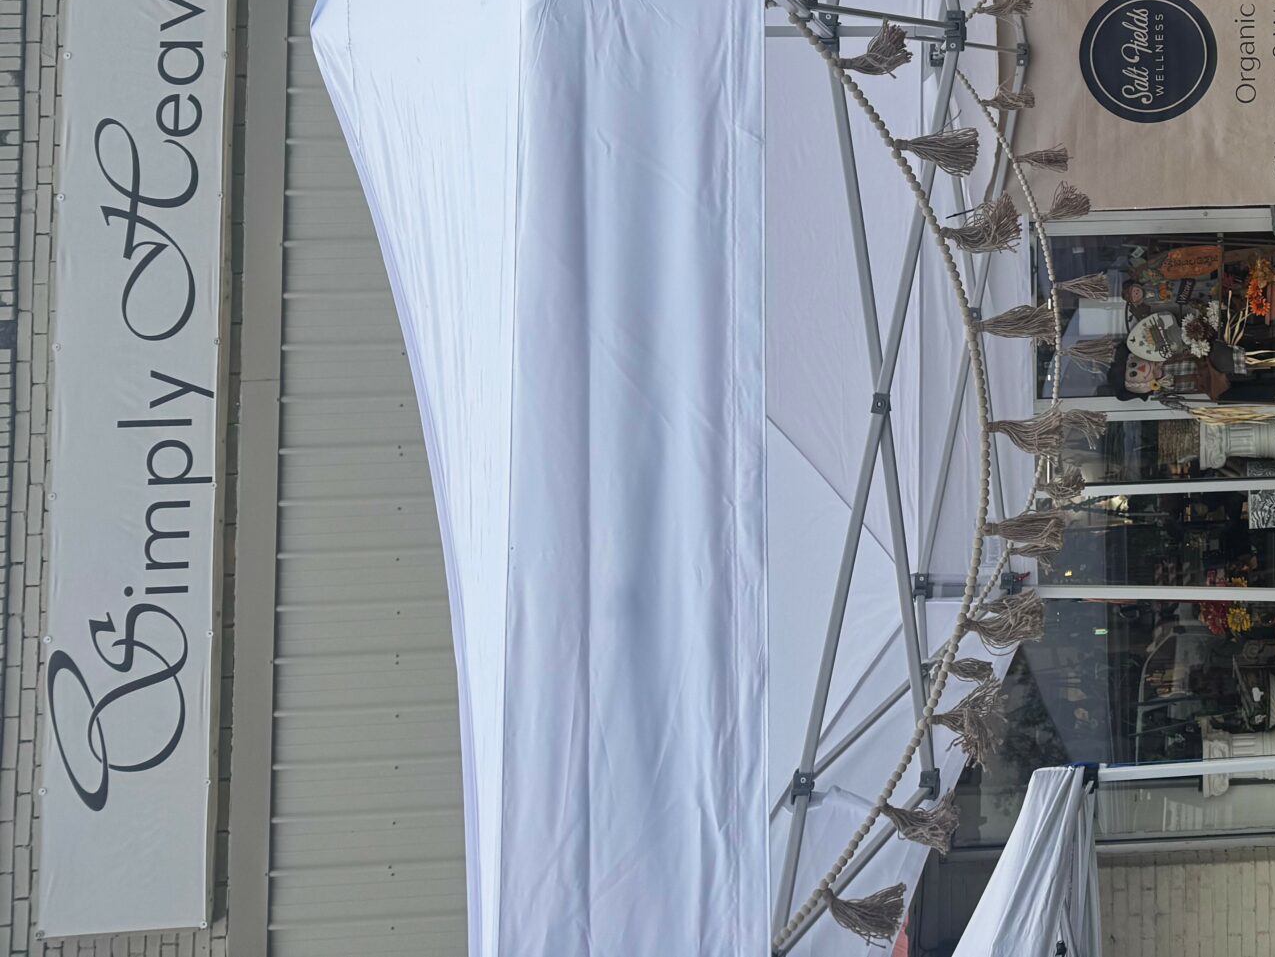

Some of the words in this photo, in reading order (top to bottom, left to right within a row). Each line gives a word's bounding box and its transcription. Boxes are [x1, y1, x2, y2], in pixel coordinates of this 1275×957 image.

[1121, 7, 1153, 64] Fields
[1155, 12, 1164, 96] WELLNESS
[1234, 2, 1261, 104] Organic
[1121, 65, 1153, 104] Salt
[47, 370, 214, 811] Simply
